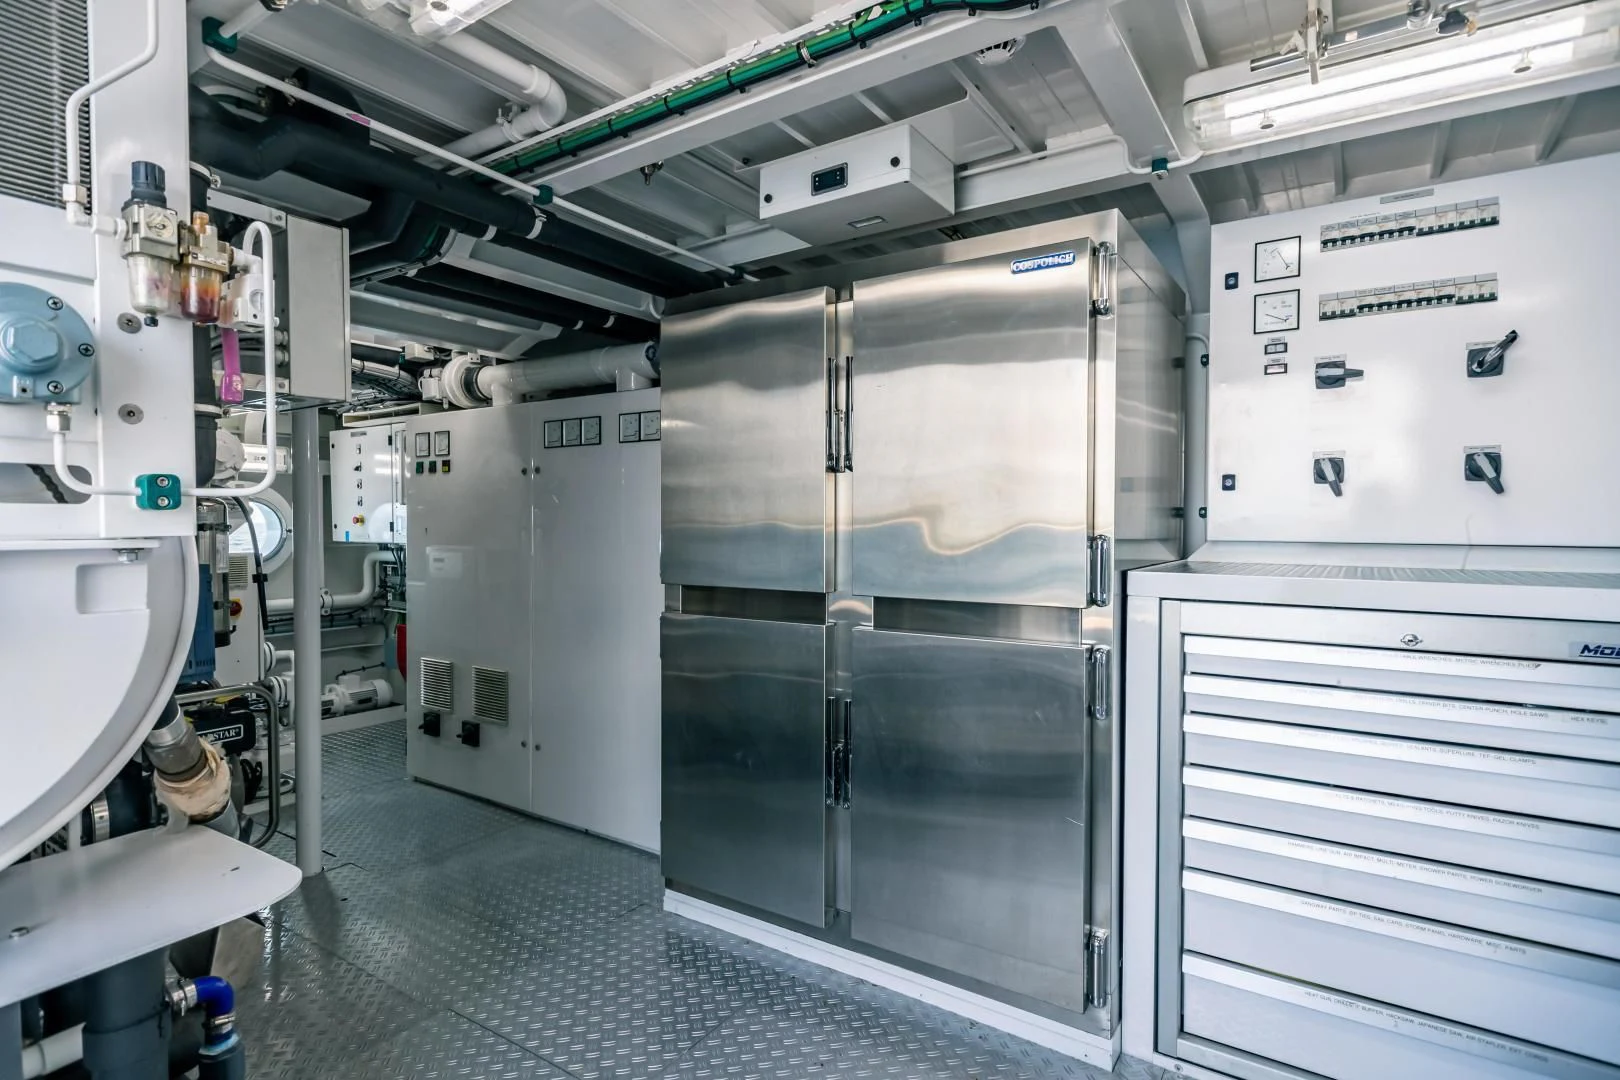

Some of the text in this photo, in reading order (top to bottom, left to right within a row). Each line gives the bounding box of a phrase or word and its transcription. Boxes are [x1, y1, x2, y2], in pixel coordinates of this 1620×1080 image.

[1012, 252, 1074, 272] COSPOLICH
[1509, 756, 1536, 765] CLAMPS
[1492, 818, 1514, 826] RAZOR
[1516, 821, 1539, 830] KNIVES
[1419, 865, 1445, 875] SHOWER
[1469, 875, 1492, 884] POWER
[1494, 880, 1542, 893] SCREWDRIVER
[1504, 944, 1526, 955] PARTS
